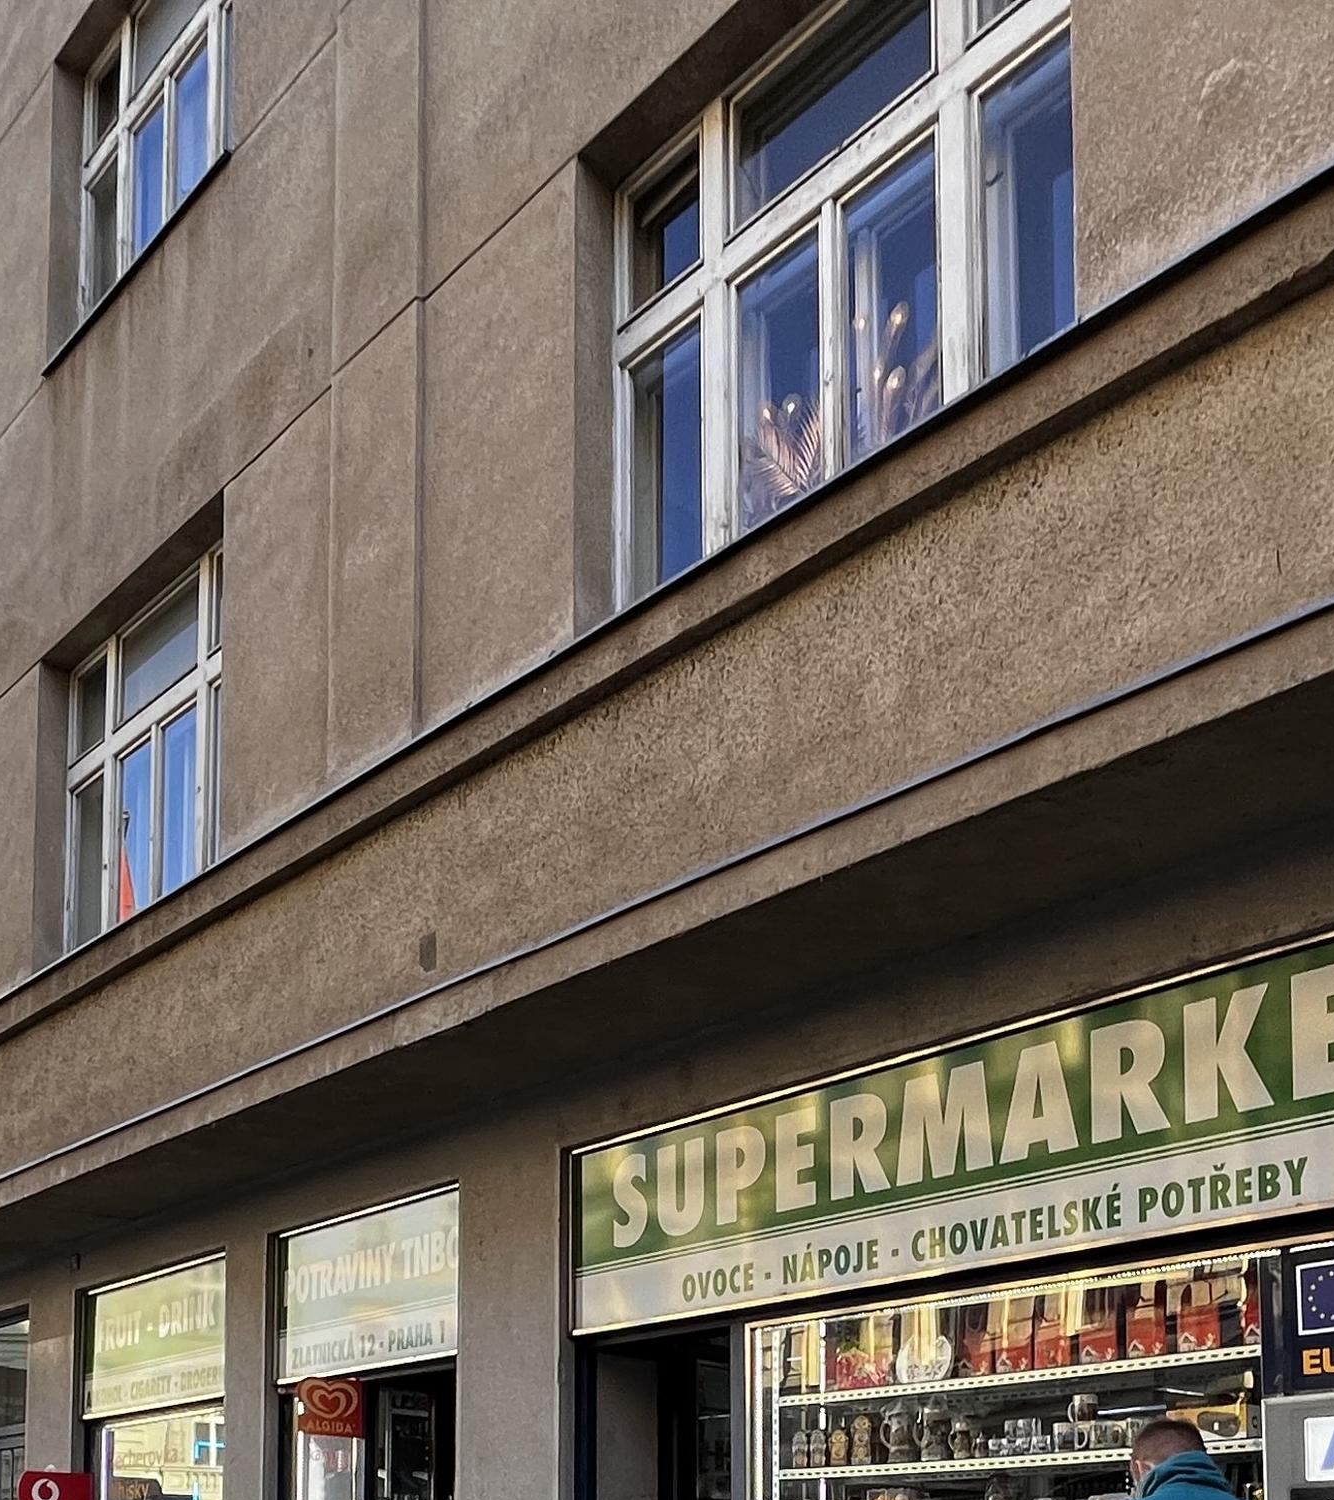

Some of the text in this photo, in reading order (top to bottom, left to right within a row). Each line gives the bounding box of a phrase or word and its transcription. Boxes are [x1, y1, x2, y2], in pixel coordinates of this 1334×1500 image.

[682, 1261, 755, 1303] OVOCE
[781, 1234, 880, 1285] NÁPOJE
[911, 1183, 1123, 1260] CHOVATELSKÉ
[1137, 1157, 1307, 1237] POTŘEBY
[284, 1242, 396, 1307] POTRAVINY
[100, 1310, 142, 1352] FRUIT
[158, 1290, 216, 1338] DRINK
[292, 1331, 355, 1369] ZLATNICKÁ
[360, 1334, 376, 1358] 12
[388, 1323, 433, 1352] PRAHA
[439, 1320, 446, 1344] 1
[307, 1420, 353, 1434] ALGIDA
[113, 1447, 178, 1470] echerovka
